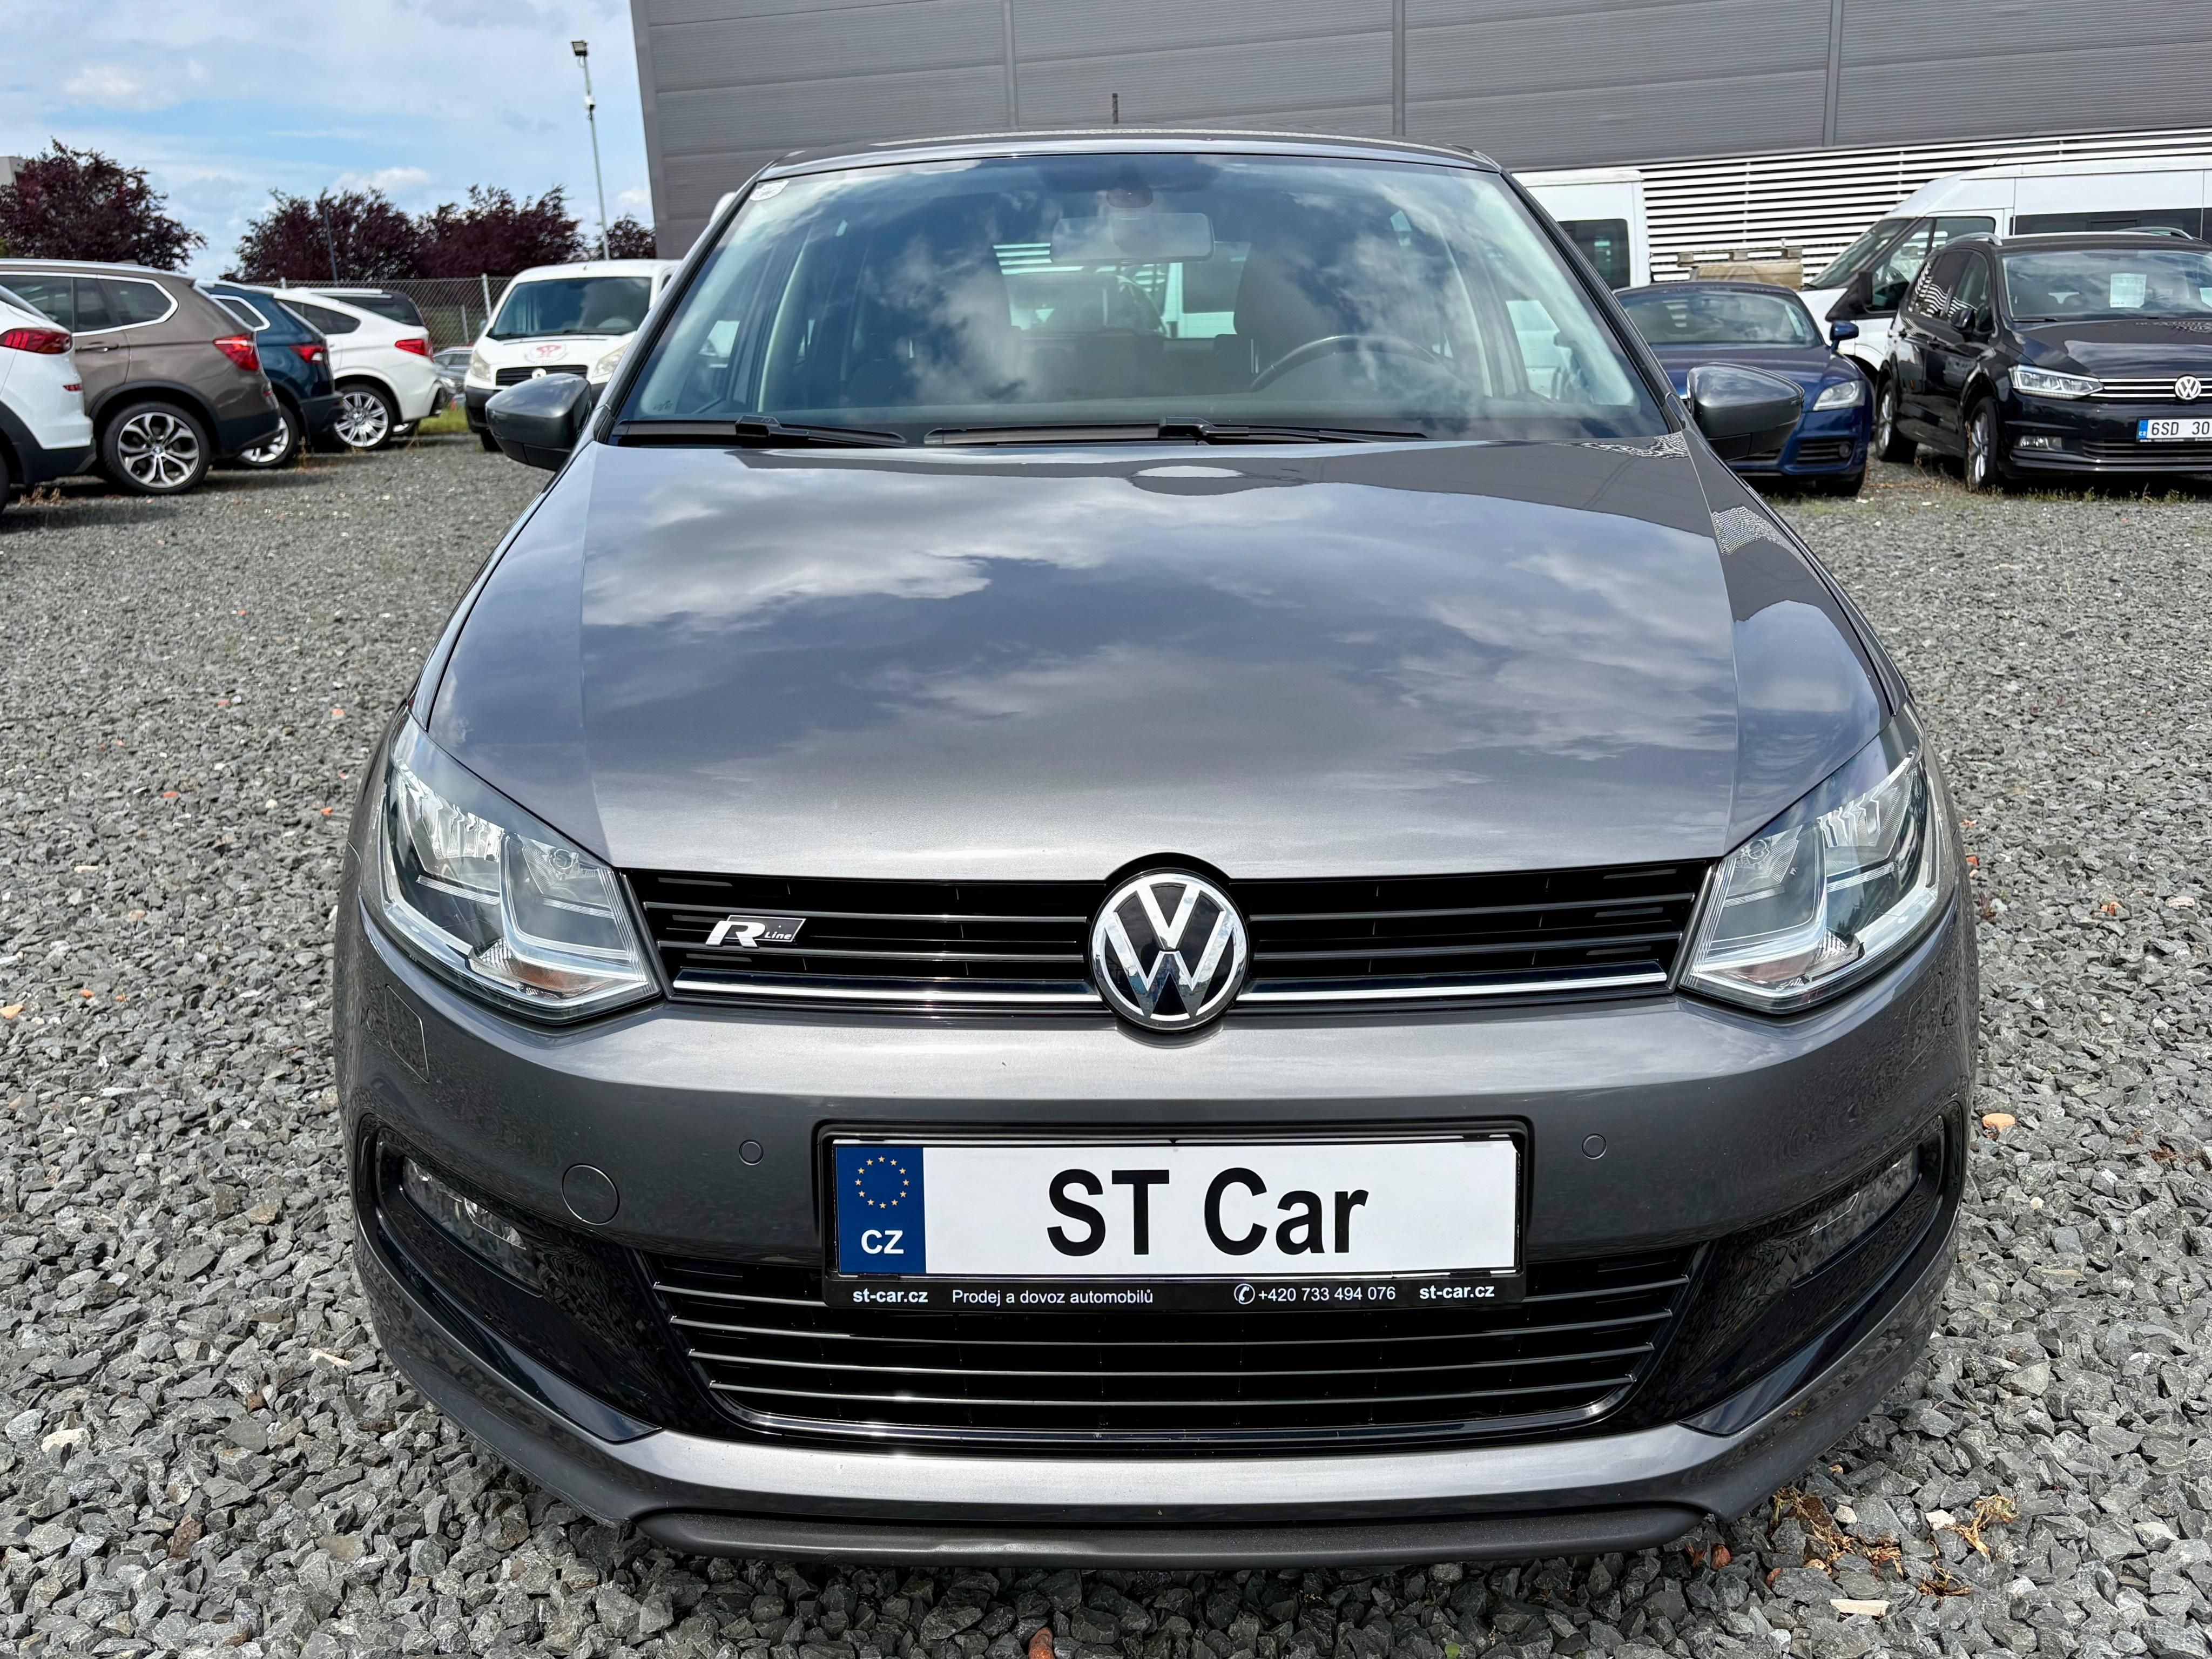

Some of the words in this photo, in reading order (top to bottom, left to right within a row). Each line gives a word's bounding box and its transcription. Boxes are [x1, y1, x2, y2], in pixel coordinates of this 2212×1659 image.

[2176, 376, 2201, 400] VW
[2151, 422, 2179, 436] 6SD
[2192, 421, 2210, 435] 30
[705, 920, 766, 948] R
[764, 929, 792, 940] Line
[1096, 875, 1244, 1024] VW
[1047, 1167, 1170, 1257] ST
[1204, 1166, 1369, 1256] Car
[861, 1229, 904, 1254] CZ
[853, 1288, 928, 1303] st-car.cz
[952, 1289, 1001, 1306] Prodej
[1006, 1293, 1015, 1304] a
[1020, 1290, 1065, 1304] dovoz
[1070, 1289, 1154, 1304] automobilů
[1258, 1288, 1297, 1301] +420
[1301, 1287, 1330, 1301] 733
[1334, 1286, 1363, 1301] 494
[1367, 1286, 1396, 1300] 076
[1419, 1285, 1495, 1299] st-car.cz
